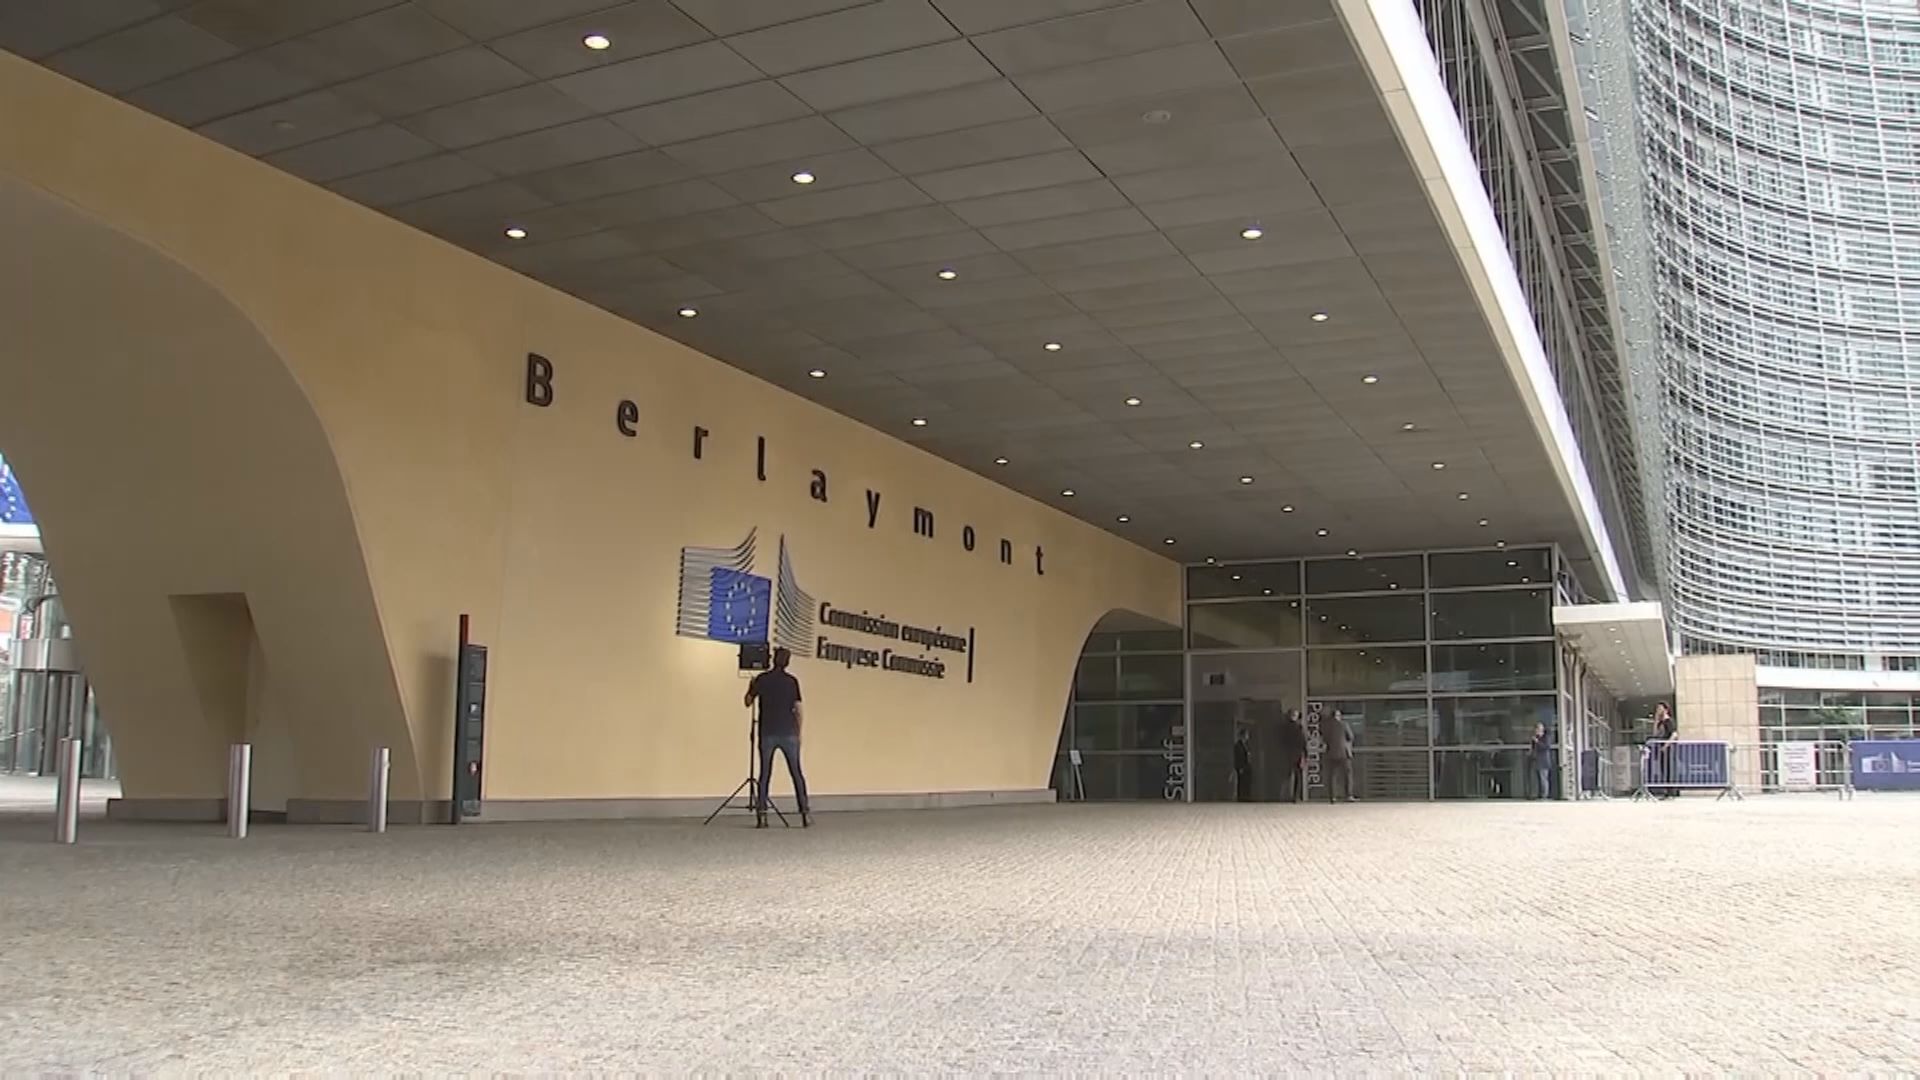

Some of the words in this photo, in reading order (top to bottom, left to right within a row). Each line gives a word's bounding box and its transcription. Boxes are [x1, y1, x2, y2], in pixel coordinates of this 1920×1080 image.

[525, 352, 1044, 576] Berlaymont
[816, 635, 879, 669] Europese
[882, 648, 945, 679] Commissie
[820, 602, 899, 639] Commission
[902, 626, 967, 653] européenne
[1164, 739, 1184, 800] Staff
[1307, 702, 1325, 788] Personnel
